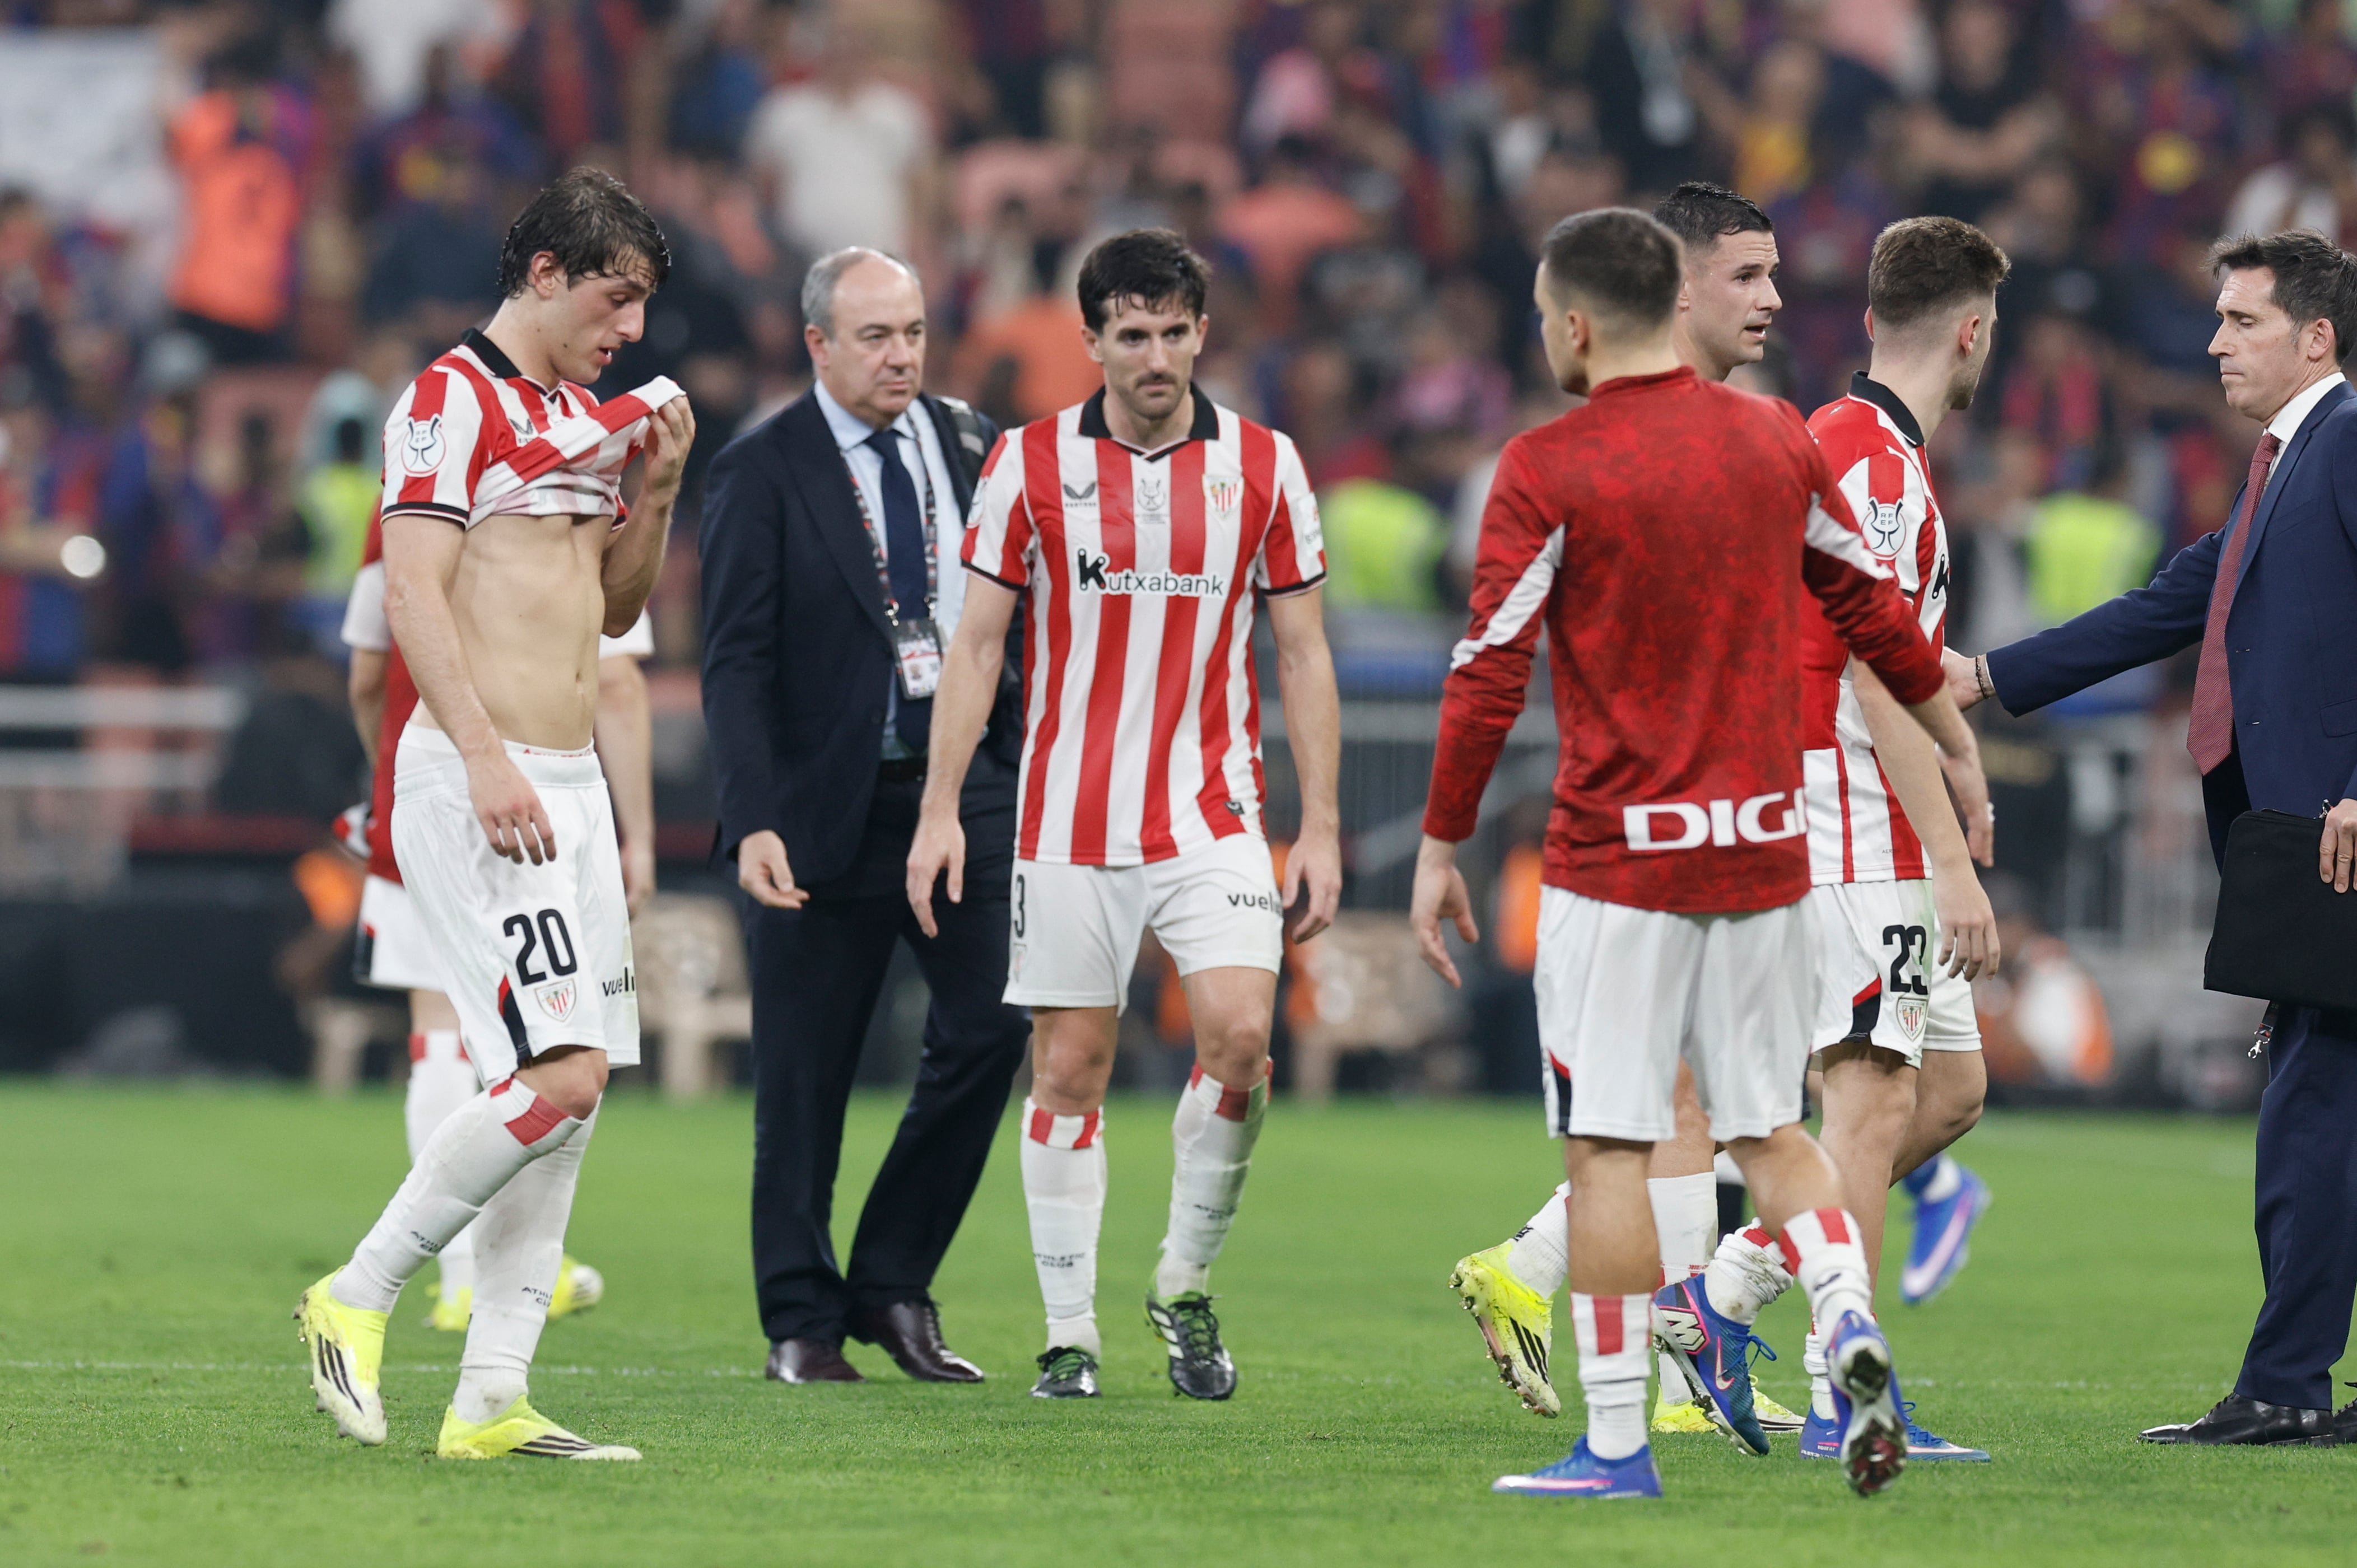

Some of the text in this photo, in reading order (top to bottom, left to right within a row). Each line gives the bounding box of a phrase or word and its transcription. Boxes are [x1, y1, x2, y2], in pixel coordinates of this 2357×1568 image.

[1078, 548, 1224, 596] Kutxabank
[1014, 874, 1025, 938] 3
[1227, 891, 1283, 915] vuel
[503, 908, 577, 987] 20
[1883, 924, 1929, 996] 23
